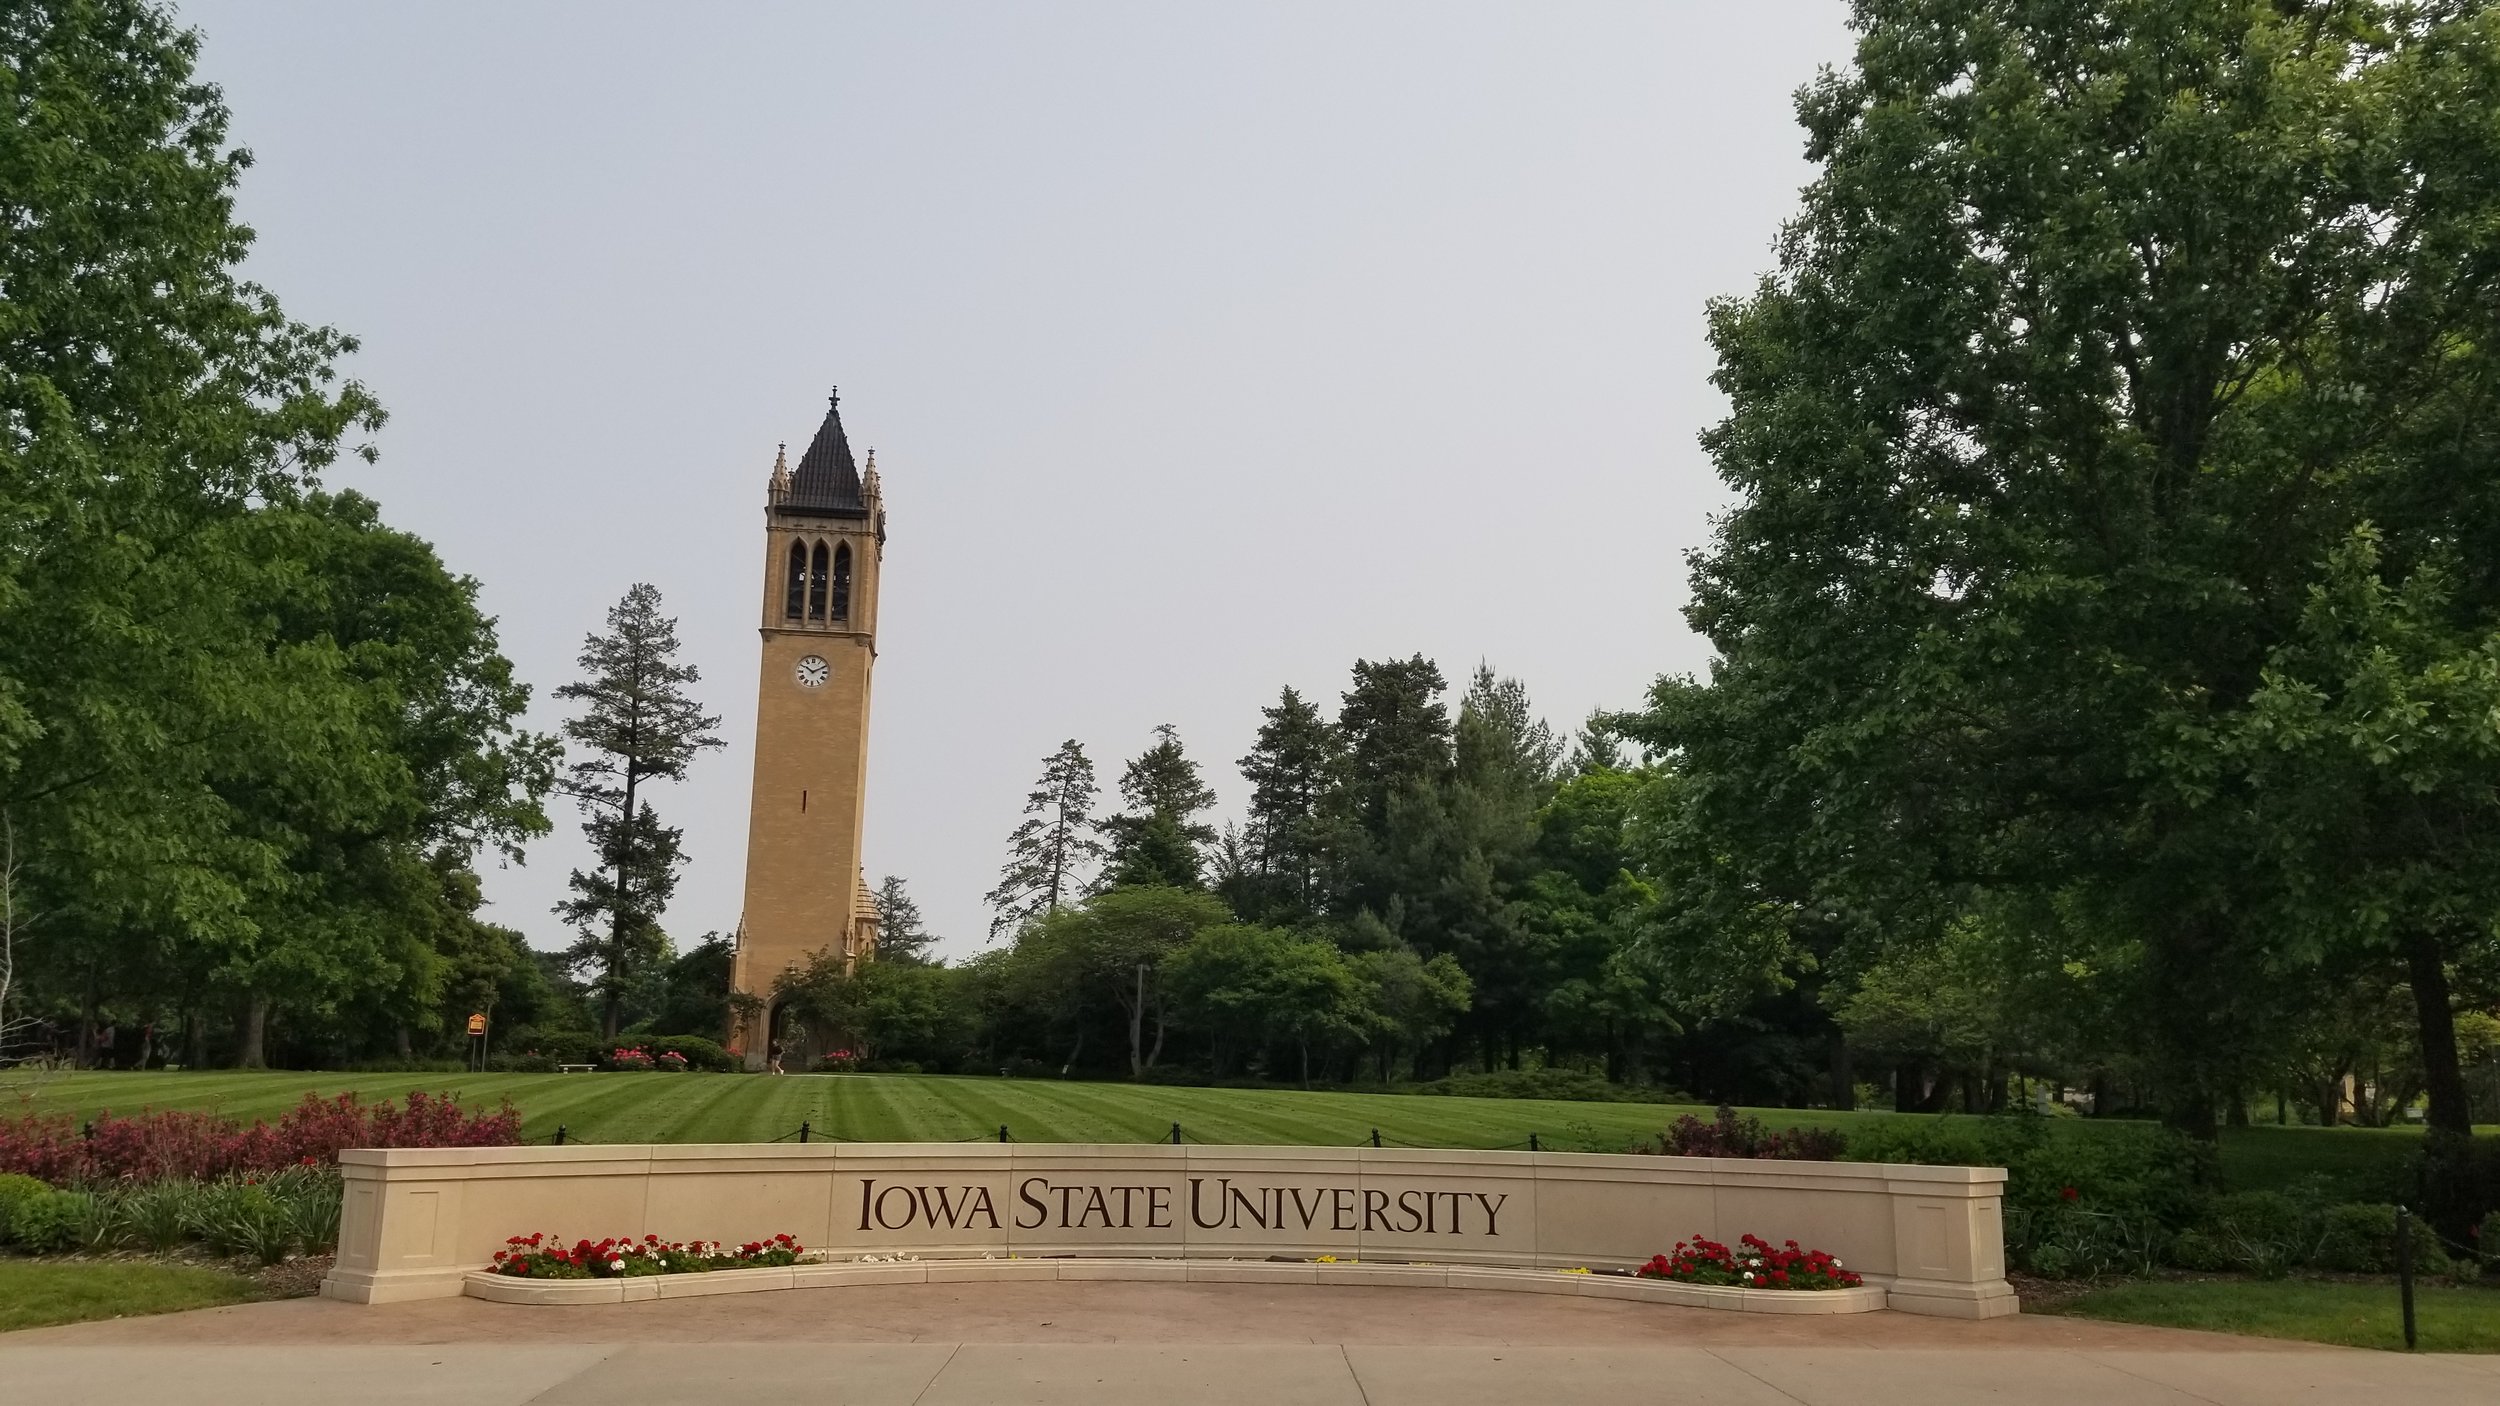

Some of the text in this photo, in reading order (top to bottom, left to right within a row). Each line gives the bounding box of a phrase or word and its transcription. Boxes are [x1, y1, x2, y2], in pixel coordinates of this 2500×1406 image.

[856, 1177, 1509, 1236] IOWA STATE UNIVERSITY
